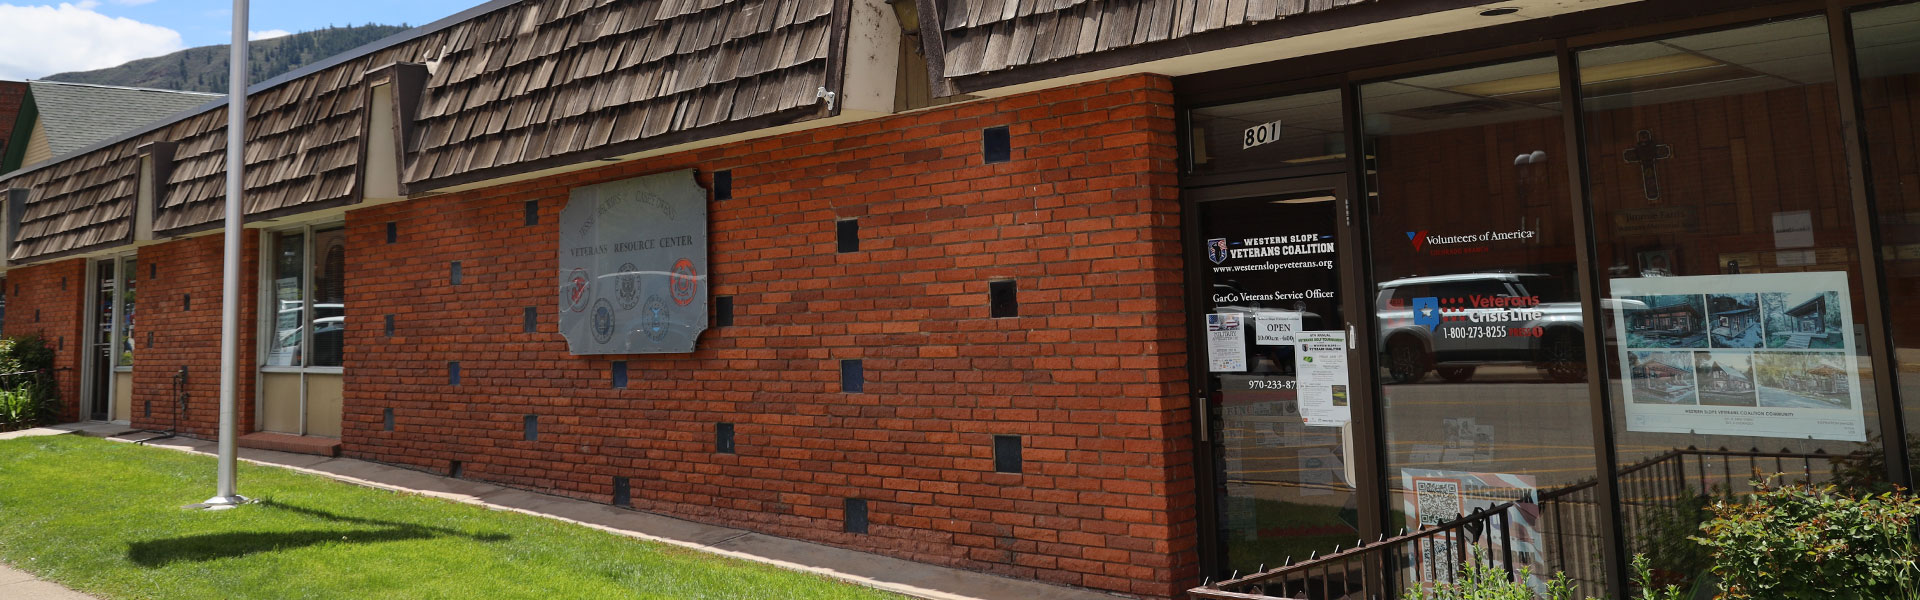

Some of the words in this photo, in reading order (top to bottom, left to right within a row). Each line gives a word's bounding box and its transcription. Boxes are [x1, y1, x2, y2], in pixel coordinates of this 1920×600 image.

[1245, 123, 1276, 146] 801
[1244, 236, 1288, 246] WESTERN
[1290, 233, 1319, 243] SLOPE
[1426, 234, 1477, 245] Volunteers
[1479, 231, 1490, 241] of
[570, 244, 608, 257] VETERANS
[614, 239, 655, 253] RESOURCE
[659, 235, 693, 248] CENTER
[1230, 247, 1281, 259] VETERANS
[1282, 242, 1335, 256] COALITION
[1213, 260, 1333, 272] www.westernslopeveterans.org
[1213, 293, 1239, 302] GarCo
[1240, 292, 1273, 301] Veterans
[1275, 290, 1304, 300] Service
[1305, 289, 1335, 299] Officer
[1469, 295, 1540, 308] Veterans
[1267, 323, 1291, 331] OPEN
[1443, 326, 1507, 339] 1-800-273-8255
[1248, 380, 1297, 390] 970-233-87
